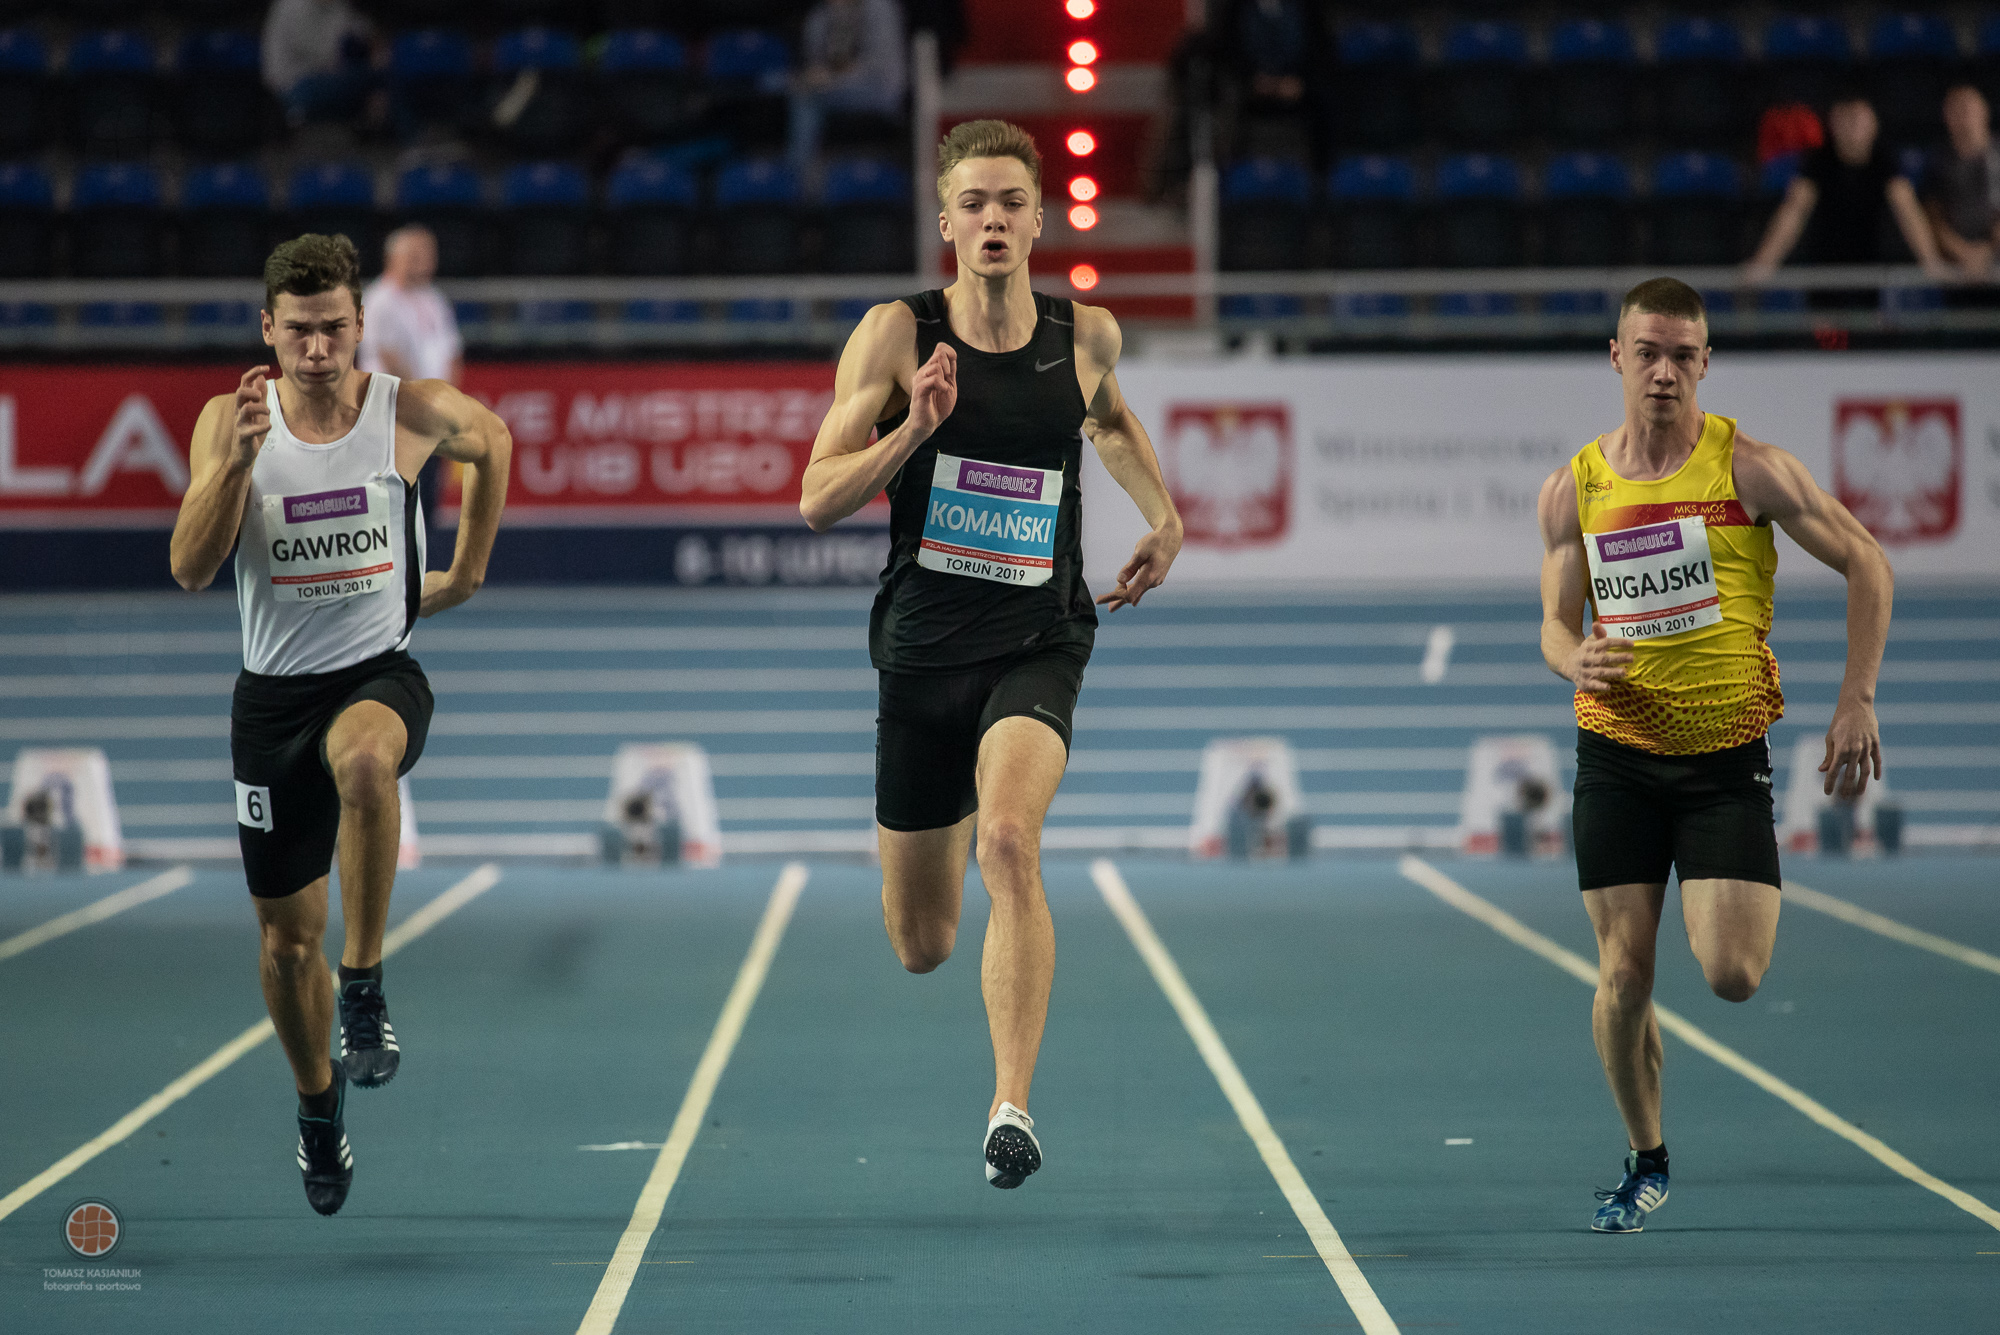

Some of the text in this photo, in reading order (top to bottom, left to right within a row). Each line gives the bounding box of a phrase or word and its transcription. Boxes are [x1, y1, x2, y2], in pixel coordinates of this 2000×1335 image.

[966, 470, 1038, 494] noskiewicz
[291, 495, 362, 518] noskiewicz
[1674, 503, 1726, 514] MKS MOS
[930, 500, 1052, 543] KOMAŃSKI
[272, 525, 388, 562] GAWRON
[1604, 530, 1676, 557] noskiewicz
[946, 557, 1026, 581] TORUŃ 2019
[1594, 560, 1710, 600] BUGAJSKI
[297, 579, 373, 598] TORUŃ 2019
[1620, 615, 1695, 637] TORUŃ 2019
[247, 790, 264, 822] 6
